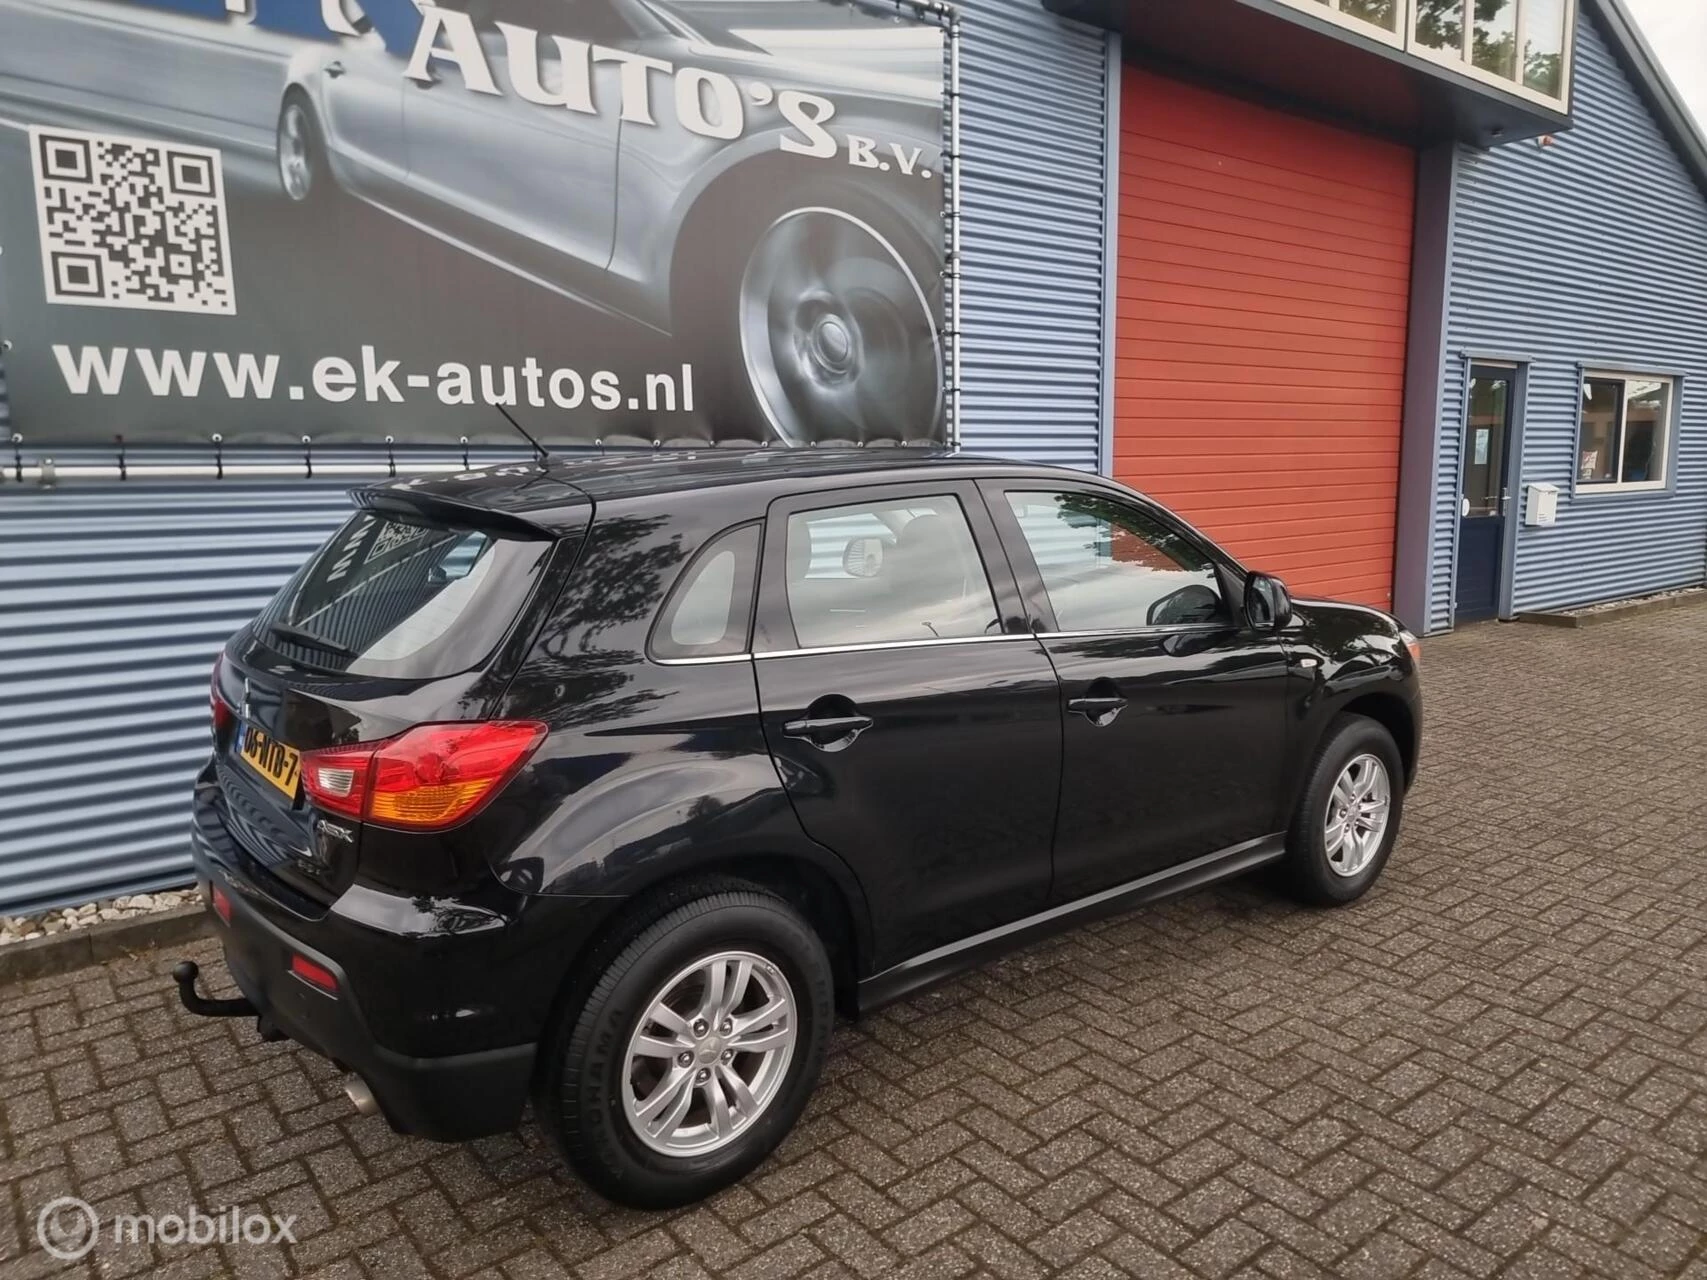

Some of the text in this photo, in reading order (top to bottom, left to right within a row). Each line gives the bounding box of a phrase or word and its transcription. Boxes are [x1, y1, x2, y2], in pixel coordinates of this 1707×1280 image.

[403, 0, 932, 179] AUTO'S B.V.
[51, 344, 694, 411] www.ek-autos.nl
